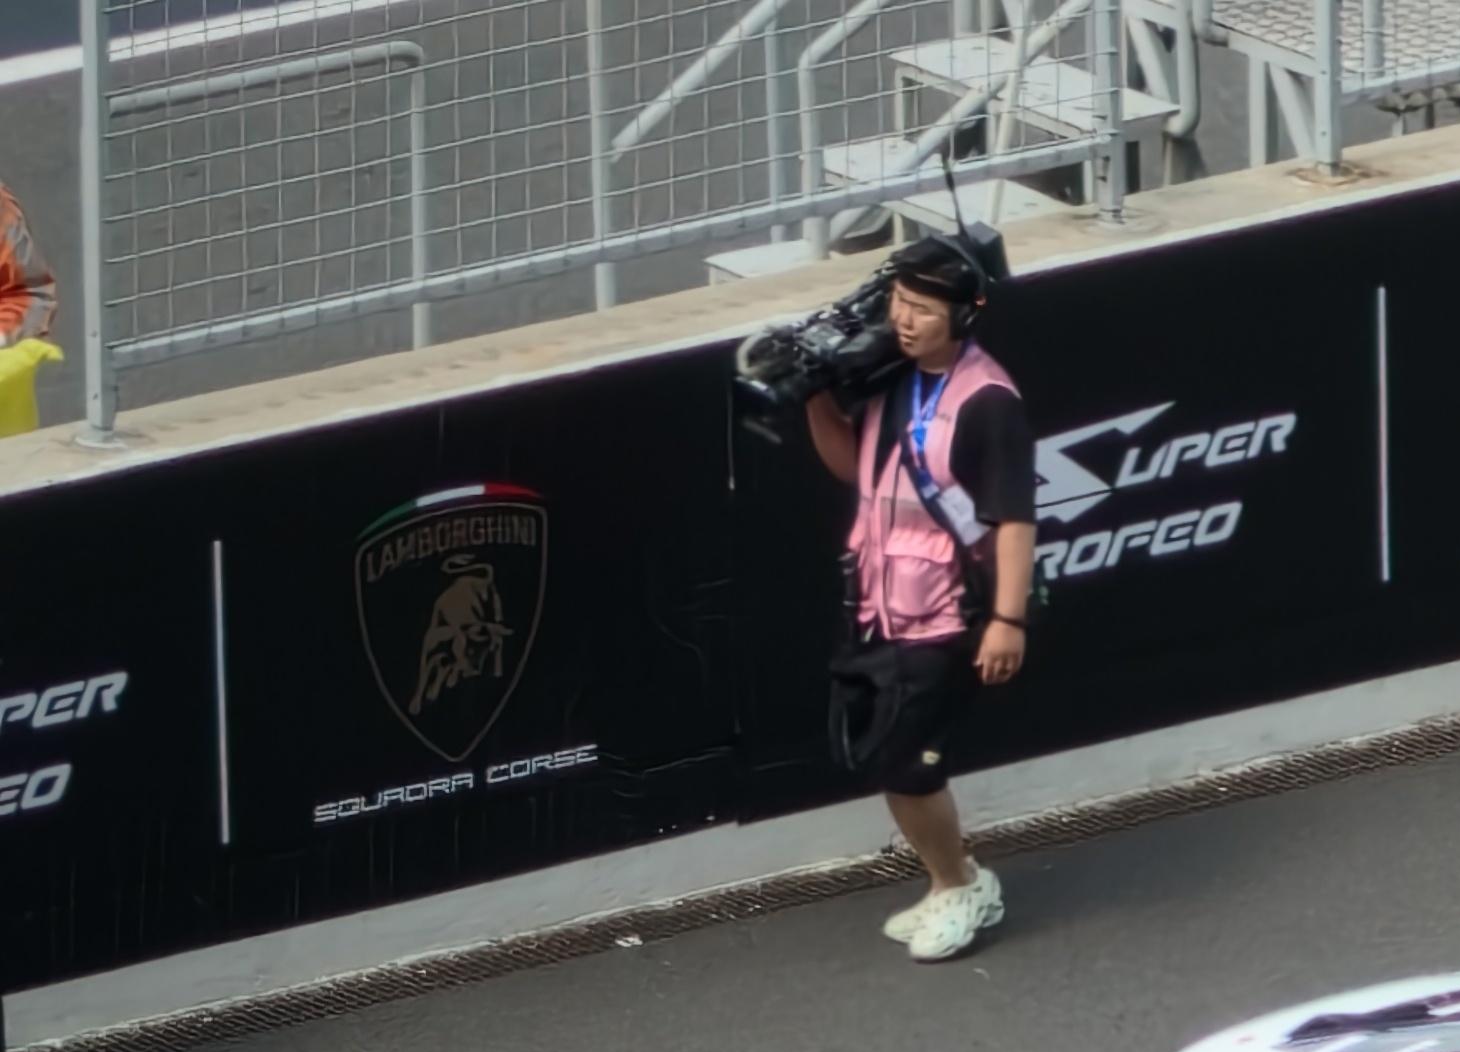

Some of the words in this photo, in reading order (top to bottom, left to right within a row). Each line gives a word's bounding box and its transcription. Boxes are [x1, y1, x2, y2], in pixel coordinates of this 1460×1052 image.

[366, 515, 536, 583] LAMBORGHINI
[1034, 490, 1242, 579] ROFEO
[313, 772, 473, 823] SQUADRA
[485, 744, 598, 783] CORSE
